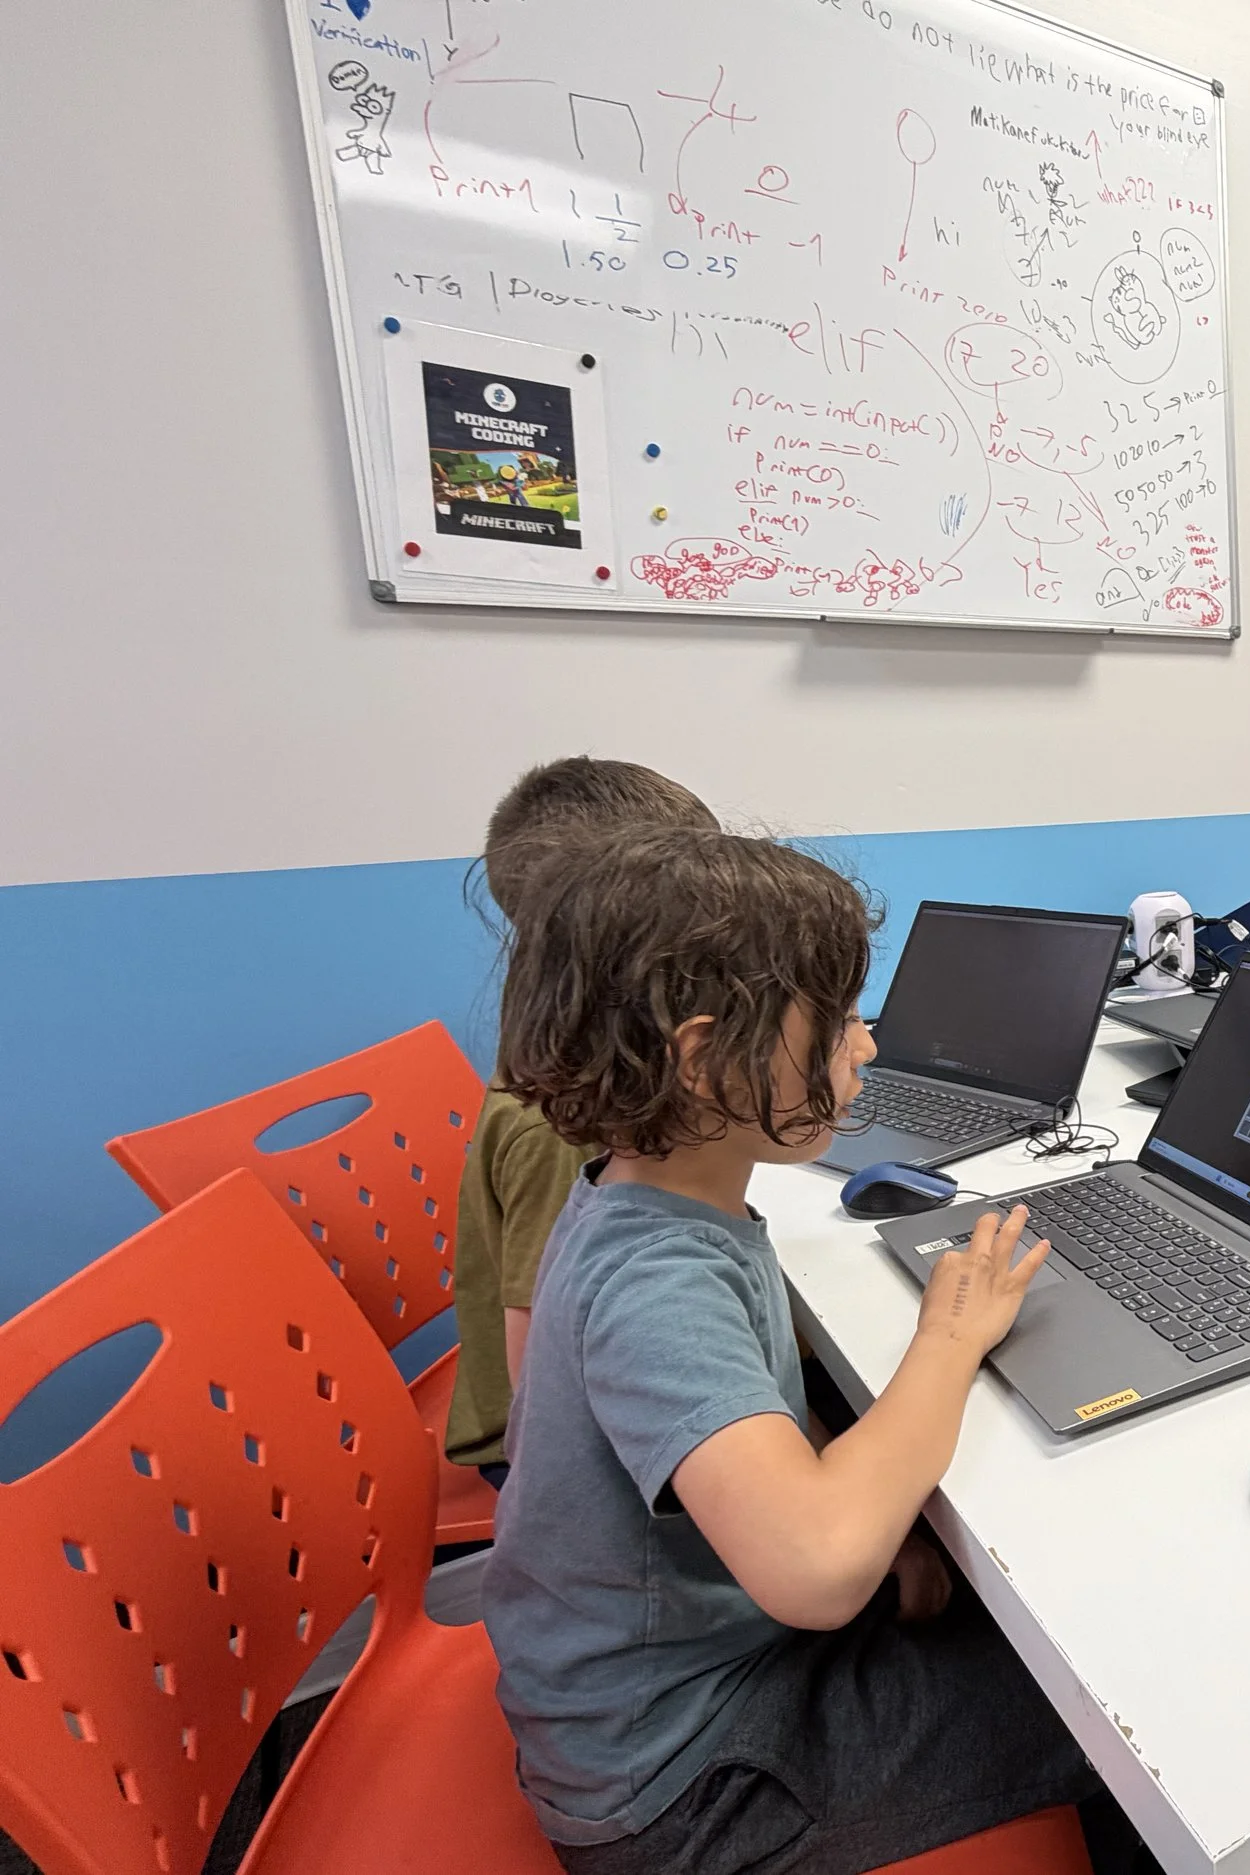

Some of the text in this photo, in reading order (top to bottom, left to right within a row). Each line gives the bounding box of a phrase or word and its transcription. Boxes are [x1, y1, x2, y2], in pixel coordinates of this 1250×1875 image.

[912, 22, 953, 53] not
[1067, 66, 1079, 92] is
[1084, 74, 1112, 97] the
[1120, 86, 1154, 112] price
[1157, 125, 1183, 144] blind
[934, 216, 960, 247] hi
[663, 249, 739, 280] 0.25
[788, 301, 887, 374] elif
[453, 410, 549, 438] MINECRAFT
[471, 427, 536, 449] CODING
[460, 512, 556, 535] MINECRAFT
[1082, 1393, 1134, 1416] Lenovo
